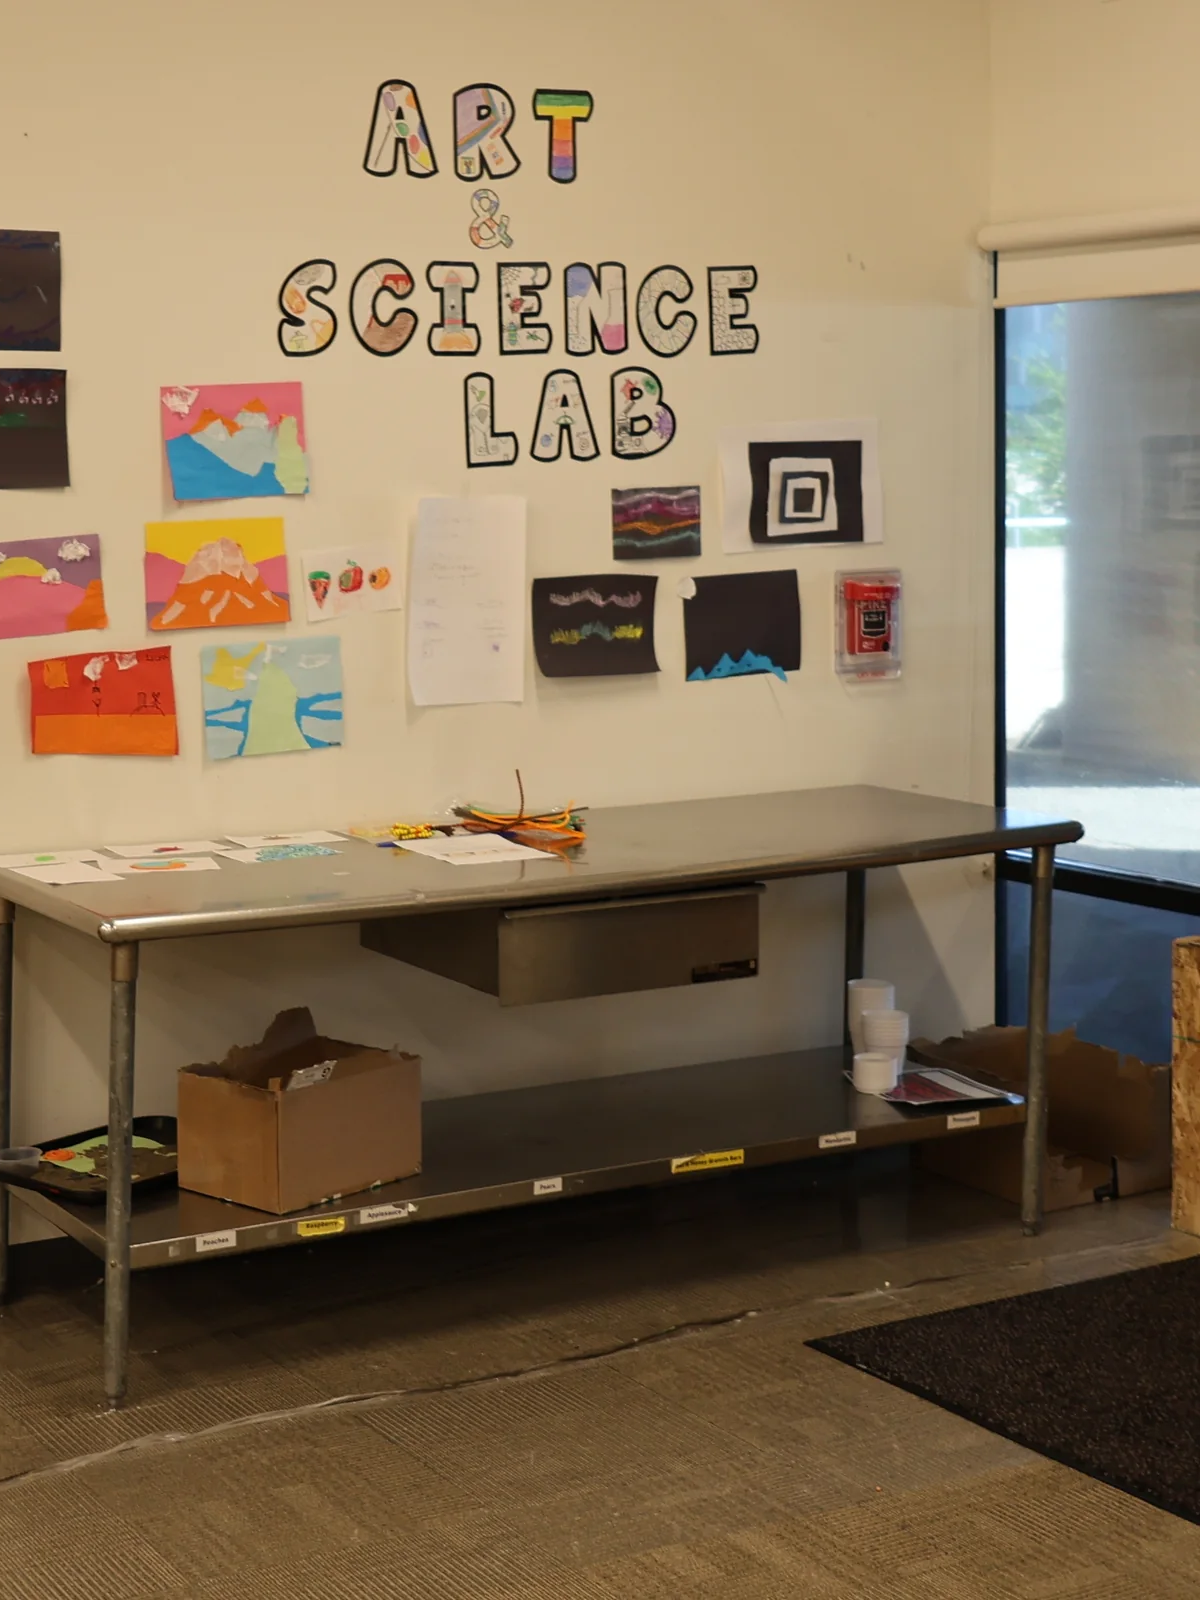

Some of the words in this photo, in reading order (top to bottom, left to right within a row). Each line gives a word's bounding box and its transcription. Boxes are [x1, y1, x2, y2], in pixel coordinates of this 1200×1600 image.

[363, 79, 595, 184] ART
[468, 188, 514, 249] &
[277, 258, 760, 358] SCIENCE
[463, 366, 677, 469] LAB
[202, 1237, 229, 1246] Peaches
[367, 1209, 403, 1219] Applesauce
